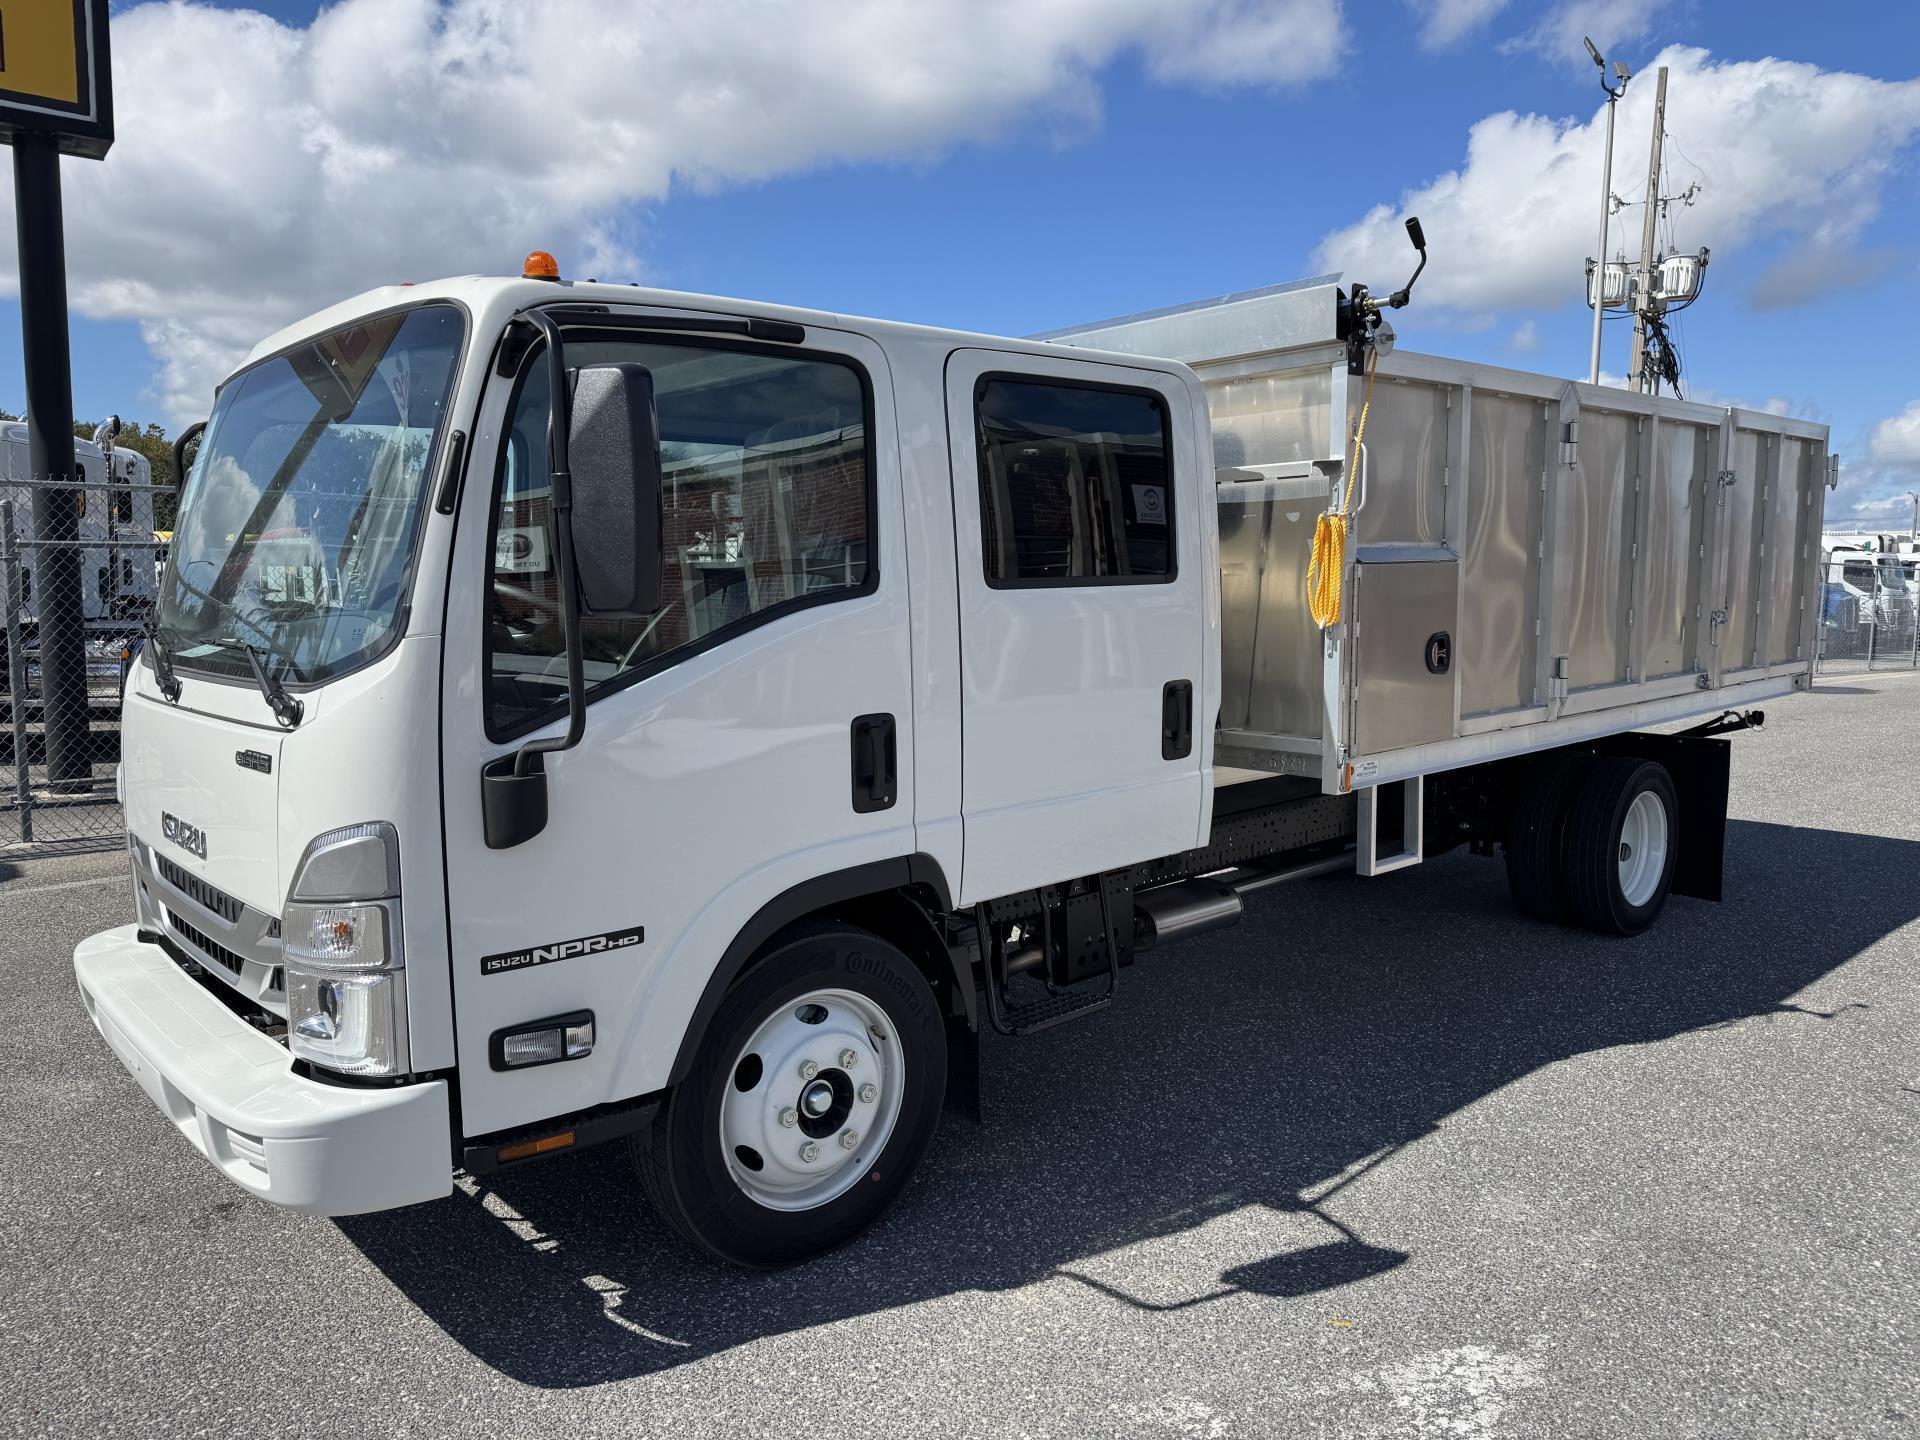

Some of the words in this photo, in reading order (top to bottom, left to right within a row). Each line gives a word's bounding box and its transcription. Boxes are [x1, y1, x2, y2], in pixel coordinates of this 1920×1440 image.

[162, 810, 207, 861] ISUZU
[488, 955, 530, 970] ISUZU
[533, 937, 607, 964] NPR
[608, 935, 639, 949] HD
[845, 951, 925, 1017] Continental
